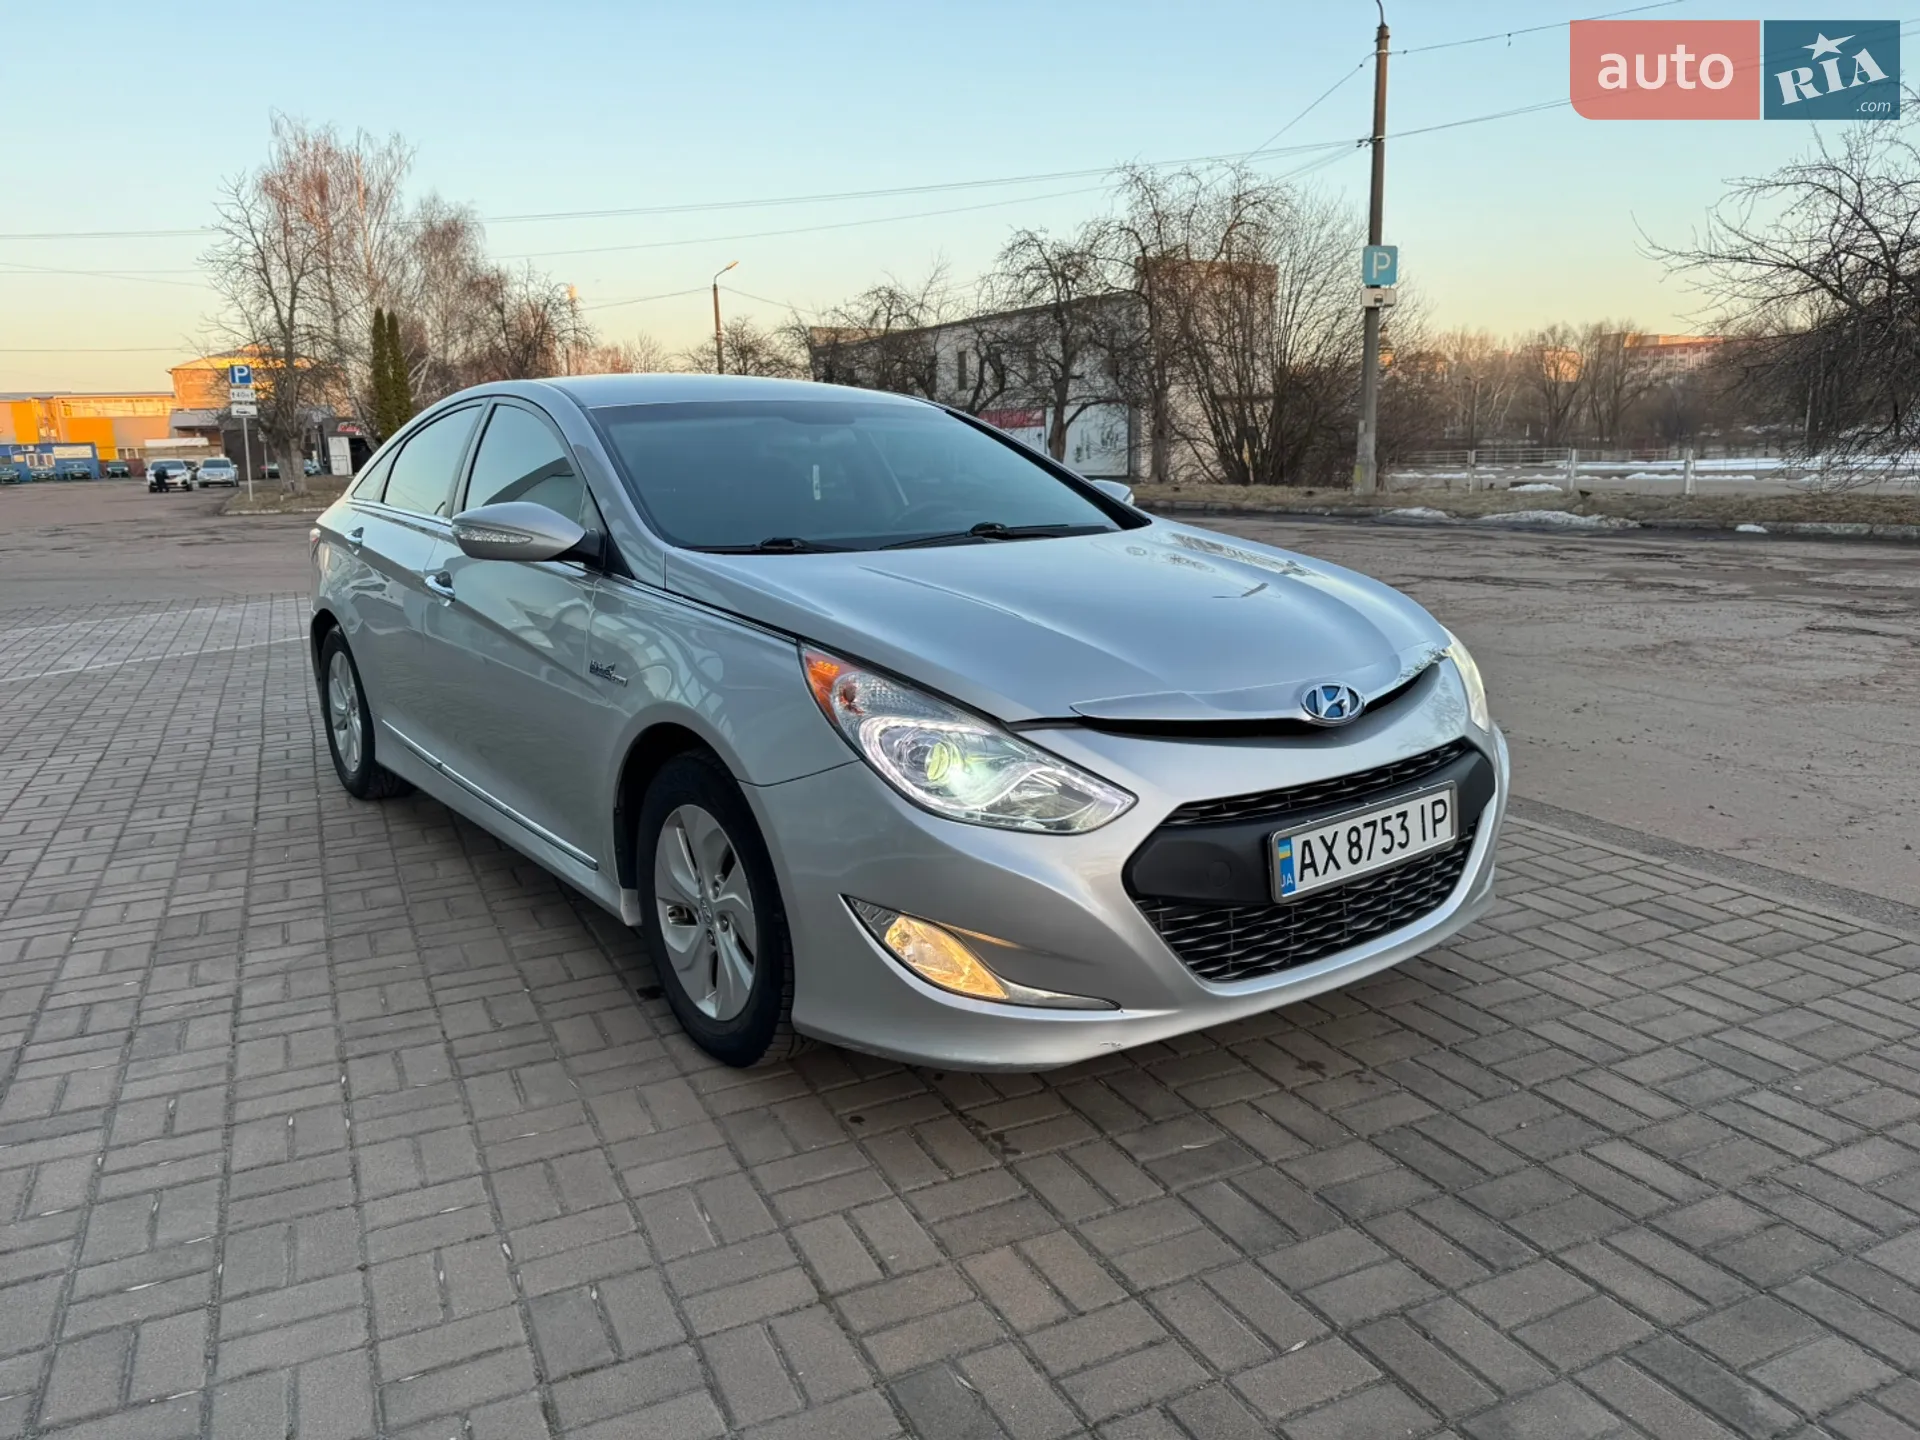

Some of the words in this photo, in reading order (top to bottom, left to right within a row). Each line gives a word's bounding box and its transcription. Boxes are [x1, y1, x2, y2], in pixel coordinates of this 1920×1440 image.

[1372, 251, 1391, 279] P
[233, 365, 249, 384] P
[1299, 831, 1341, 882] AX
[1347, 810, 1410, 865] 8753
[1420, 799, 1448, 842] IP
